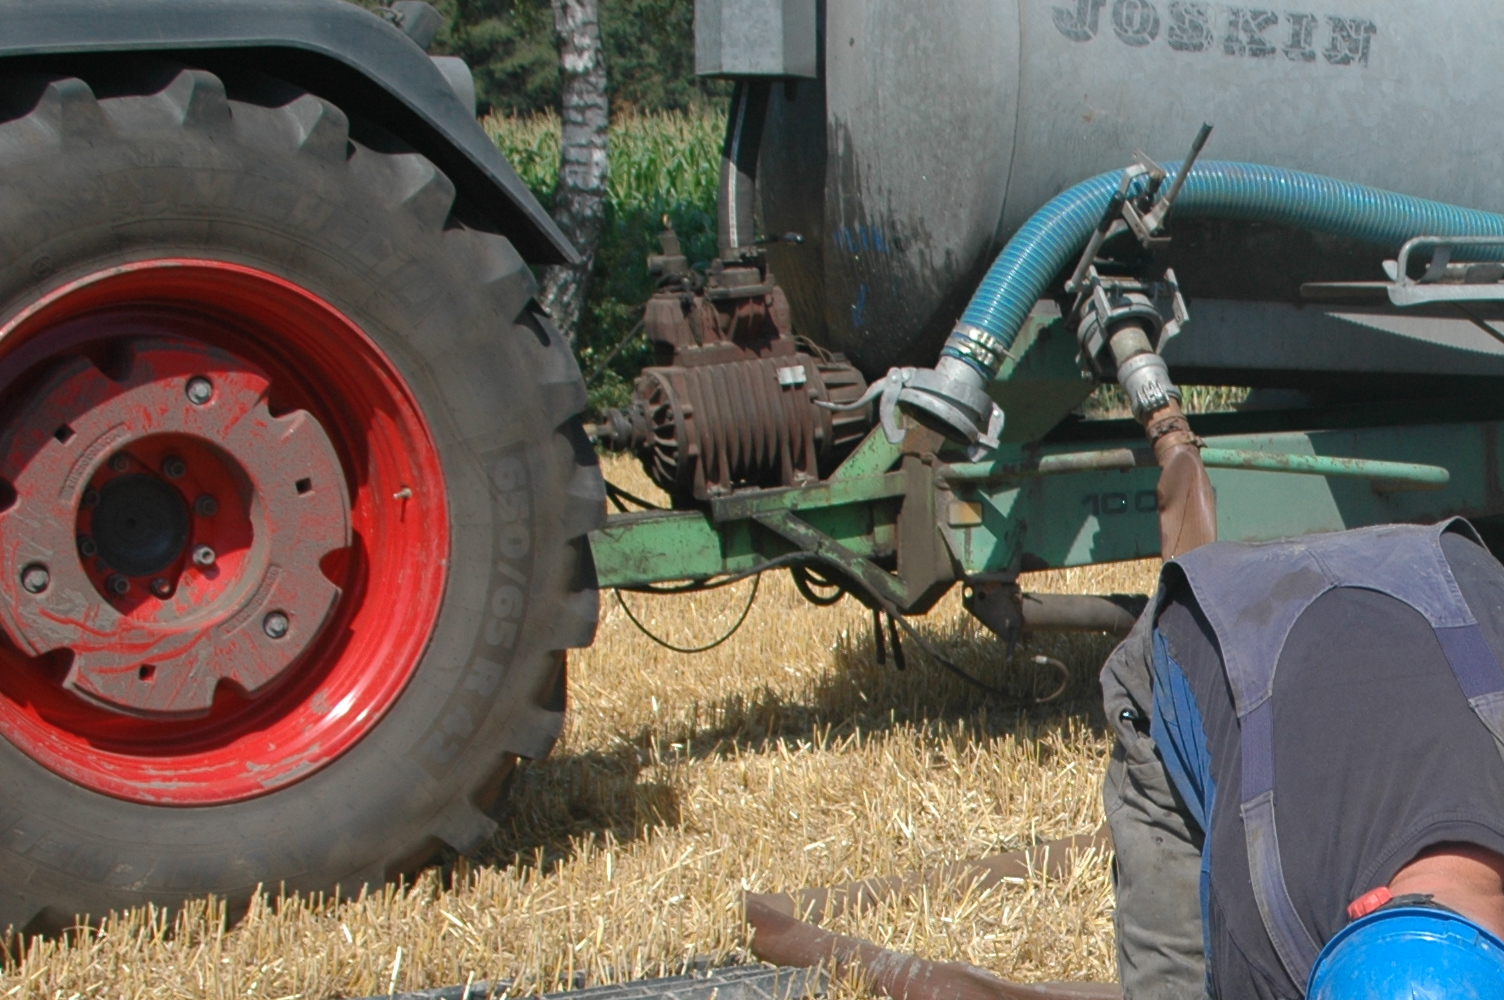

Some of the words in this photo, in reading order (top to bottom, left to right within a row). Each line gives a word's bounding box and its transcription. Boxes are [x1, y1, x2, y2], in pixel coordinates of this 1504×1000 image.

[1052, 0, 1377, 68] JOSKIN
[484, 453, 532, 651] 650/65
[463, 655, 505, 698] R
